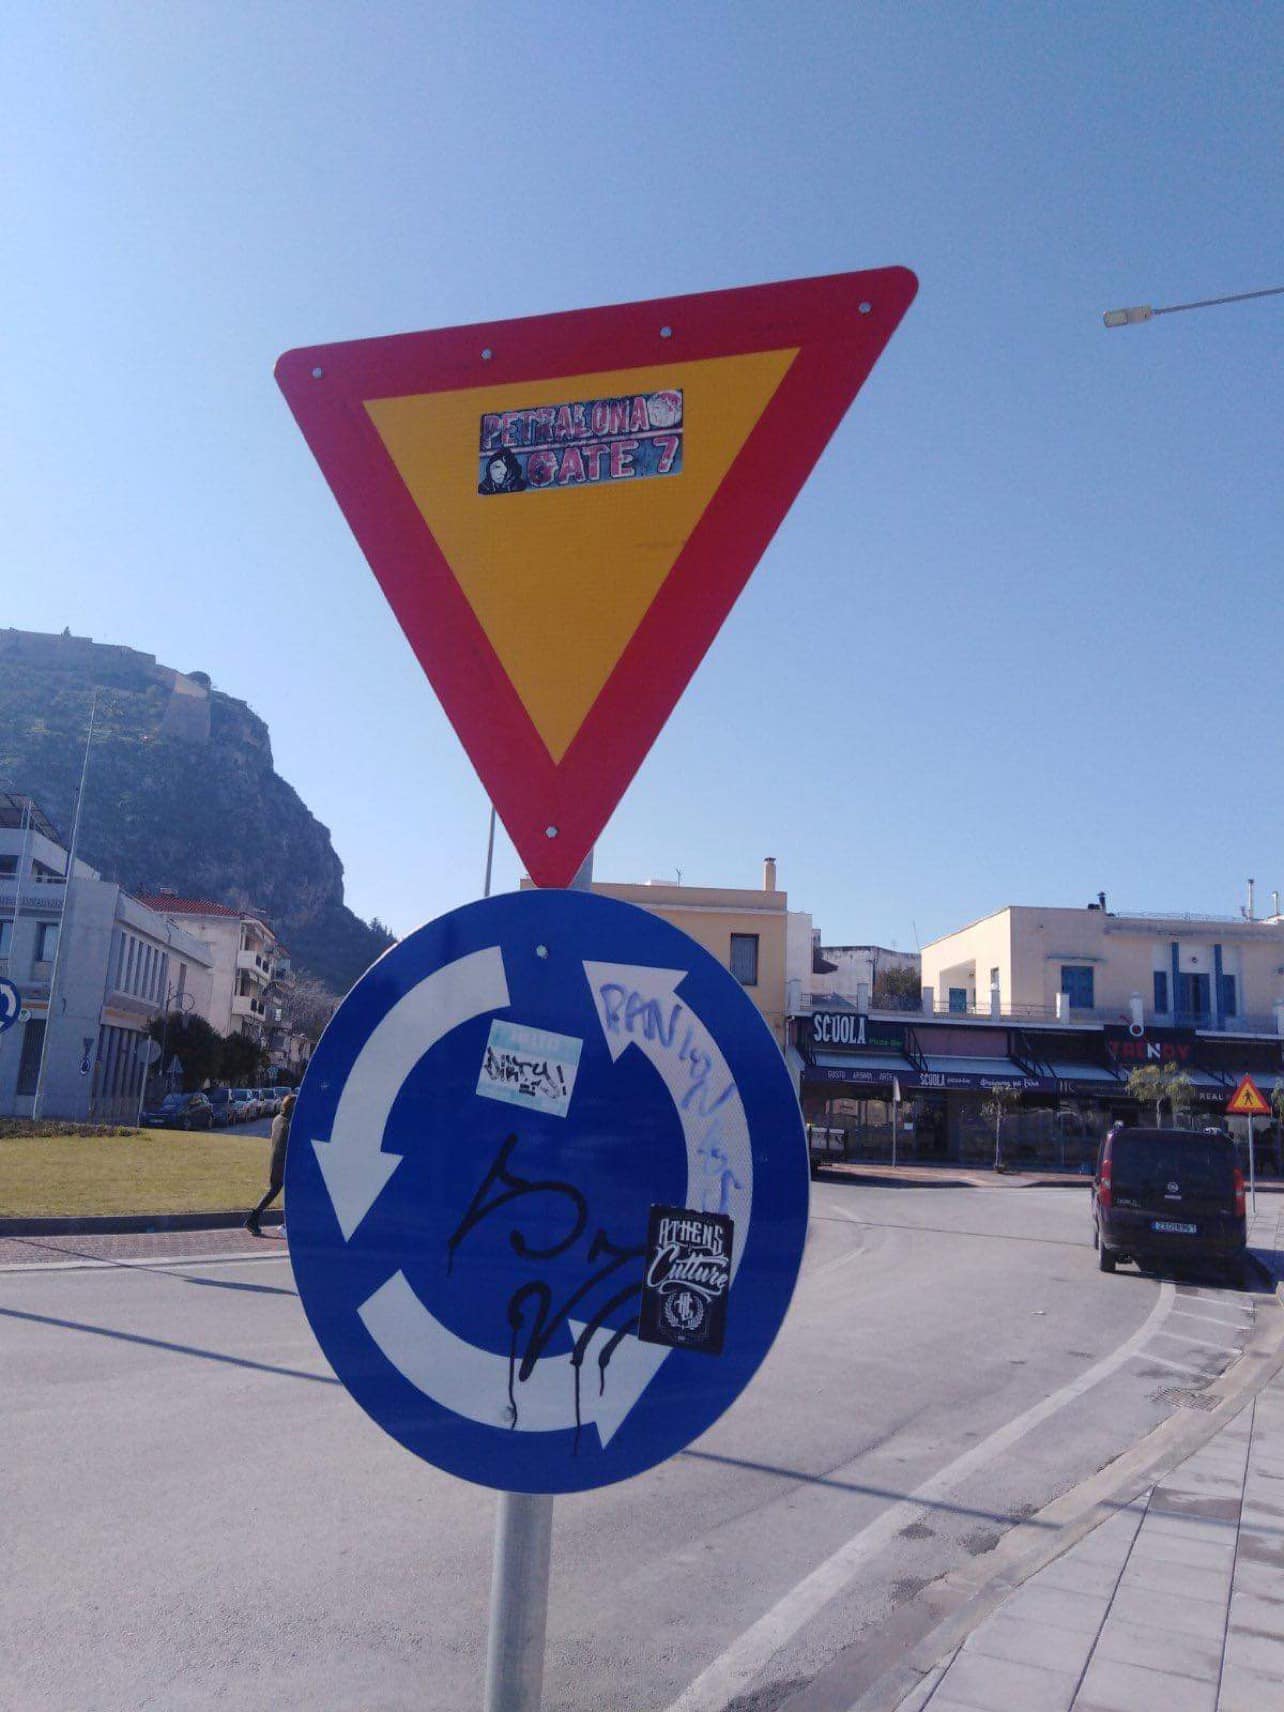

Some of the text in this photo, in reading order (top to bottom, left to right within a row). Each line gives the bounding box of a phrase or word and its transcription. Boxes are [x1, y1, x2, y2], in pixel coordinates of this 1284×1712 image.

[481, 396, 650, 449] PETRALONA
[527, 436, 679, 488] GATE 7
[813, 1014, 866, 1044] SCUOLA
[920, 1073, 945, 1087] SCUOLA
[659, 1218, 724, 1256] ATHENS
[647, 1244, 729, 1296] Culture
